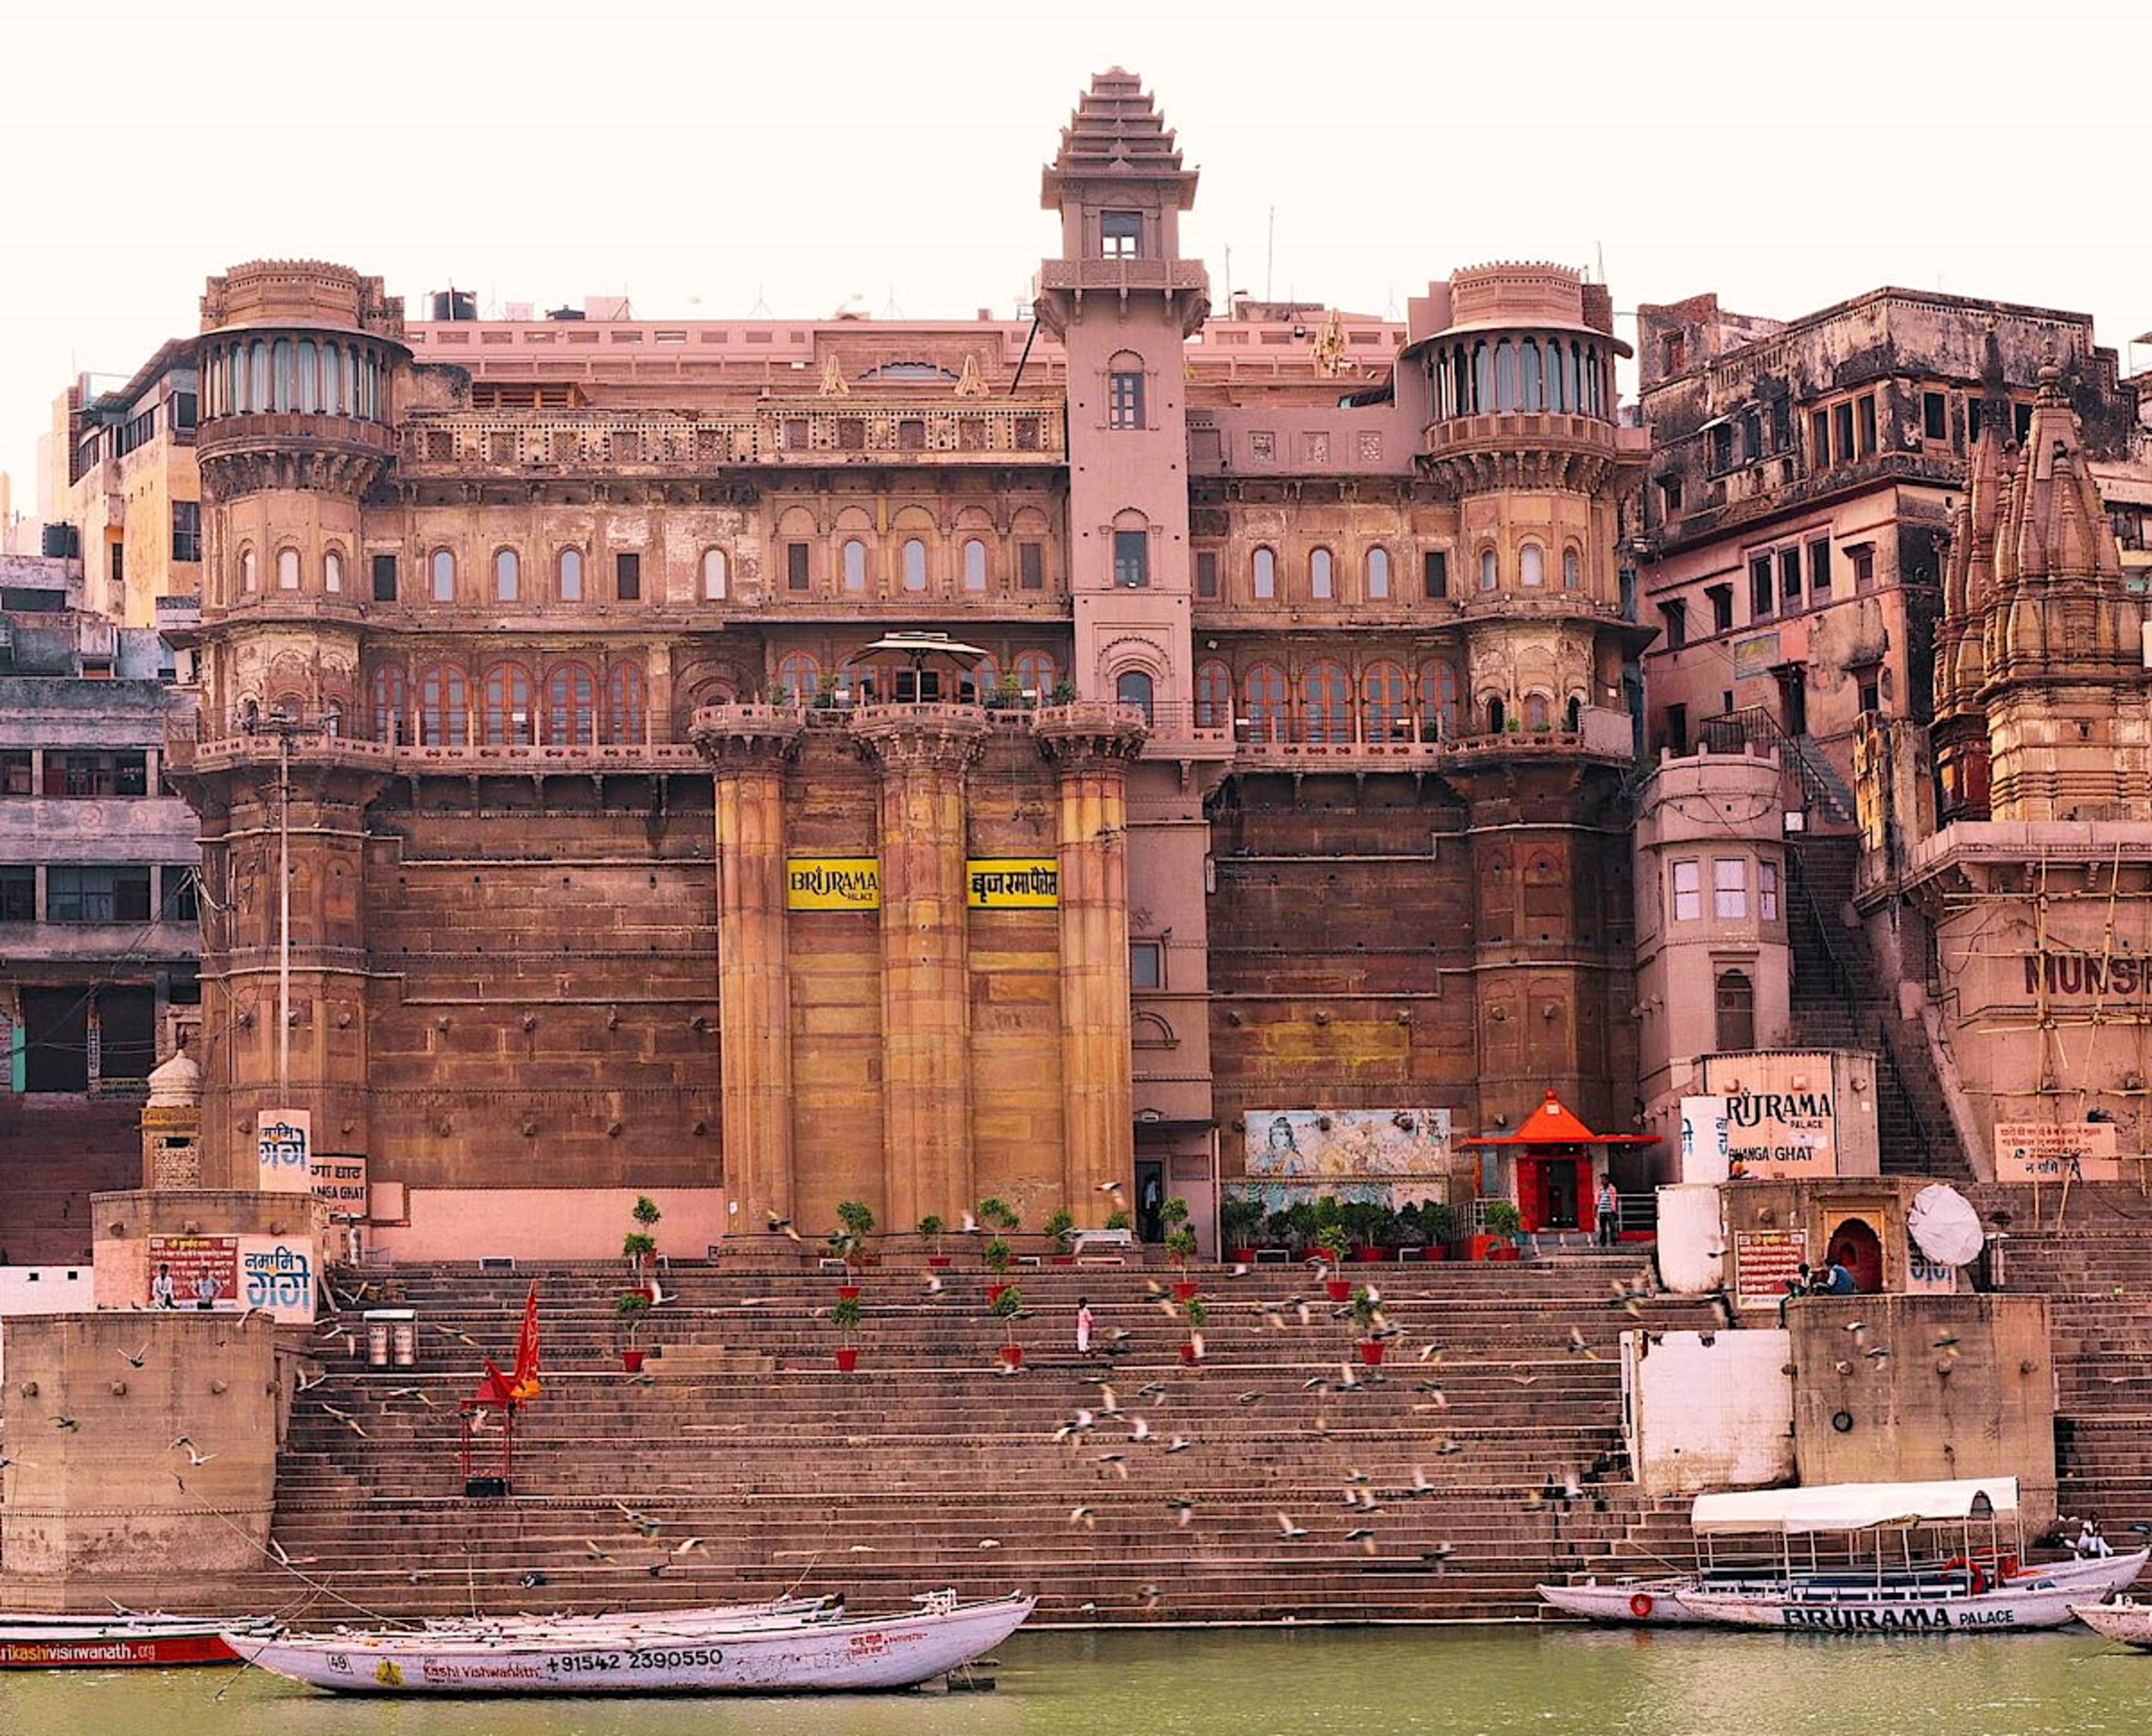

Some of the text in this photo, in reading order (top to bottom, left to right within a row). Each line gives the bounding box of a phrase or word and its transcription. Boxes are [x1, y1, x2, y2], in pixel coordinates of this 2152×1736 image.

[1775, 1146, 1812, 1161] GHAT
[340, 1186, 364, 1200] GHAT
[1960, 1610, 2014, 1624] PALACE
[548, 1649, 723, 1673] +91542 2390550
